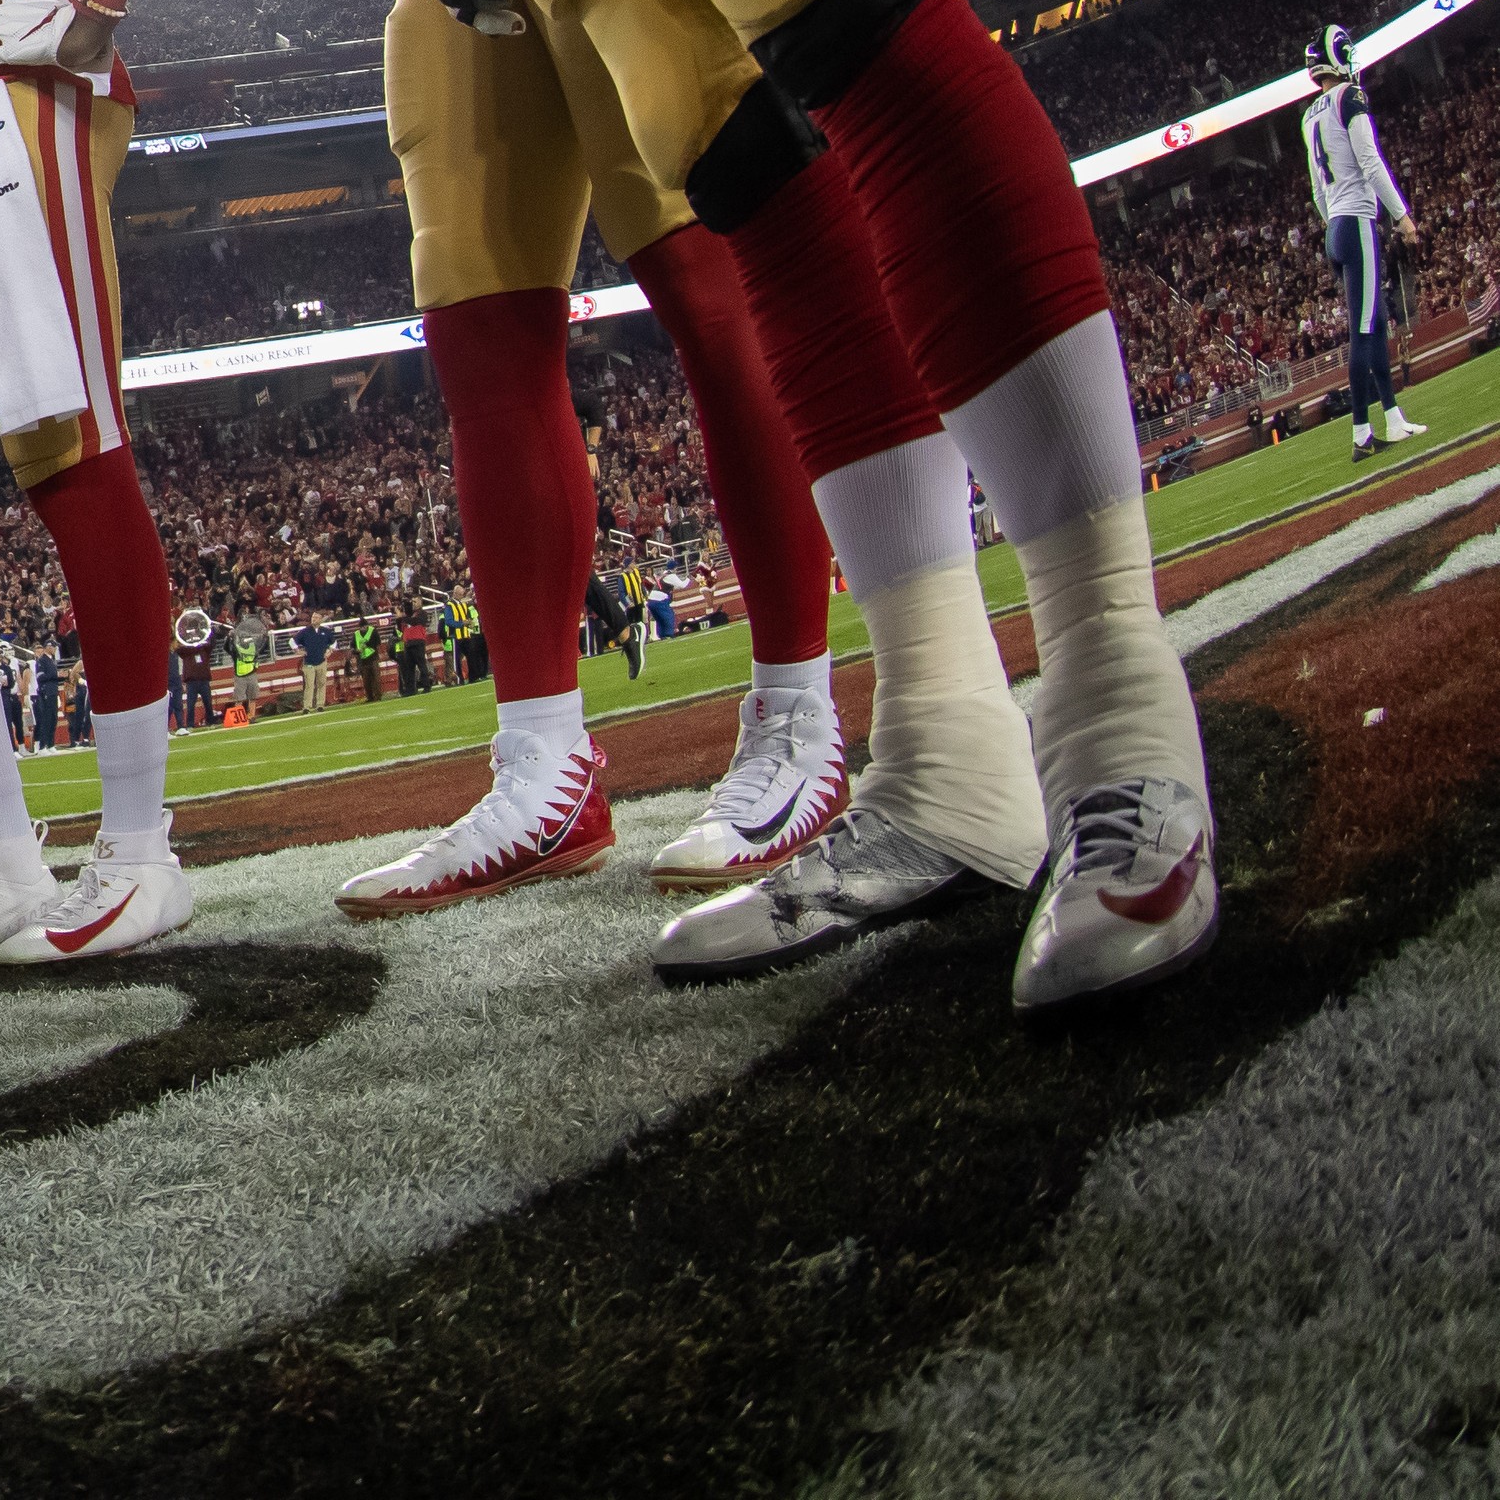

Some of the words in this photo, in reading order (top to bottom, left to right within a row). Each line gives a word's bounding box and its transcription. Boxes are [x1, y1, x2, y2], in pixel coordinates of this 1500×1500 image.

[1313, 120, 1335, 185] 4
[154, 360, 199, 377] CREEK
[215, 352, 264, 368] CASINO
[268, 345, 312, 361] RESORT
[233, 709, 247, 724] 30
